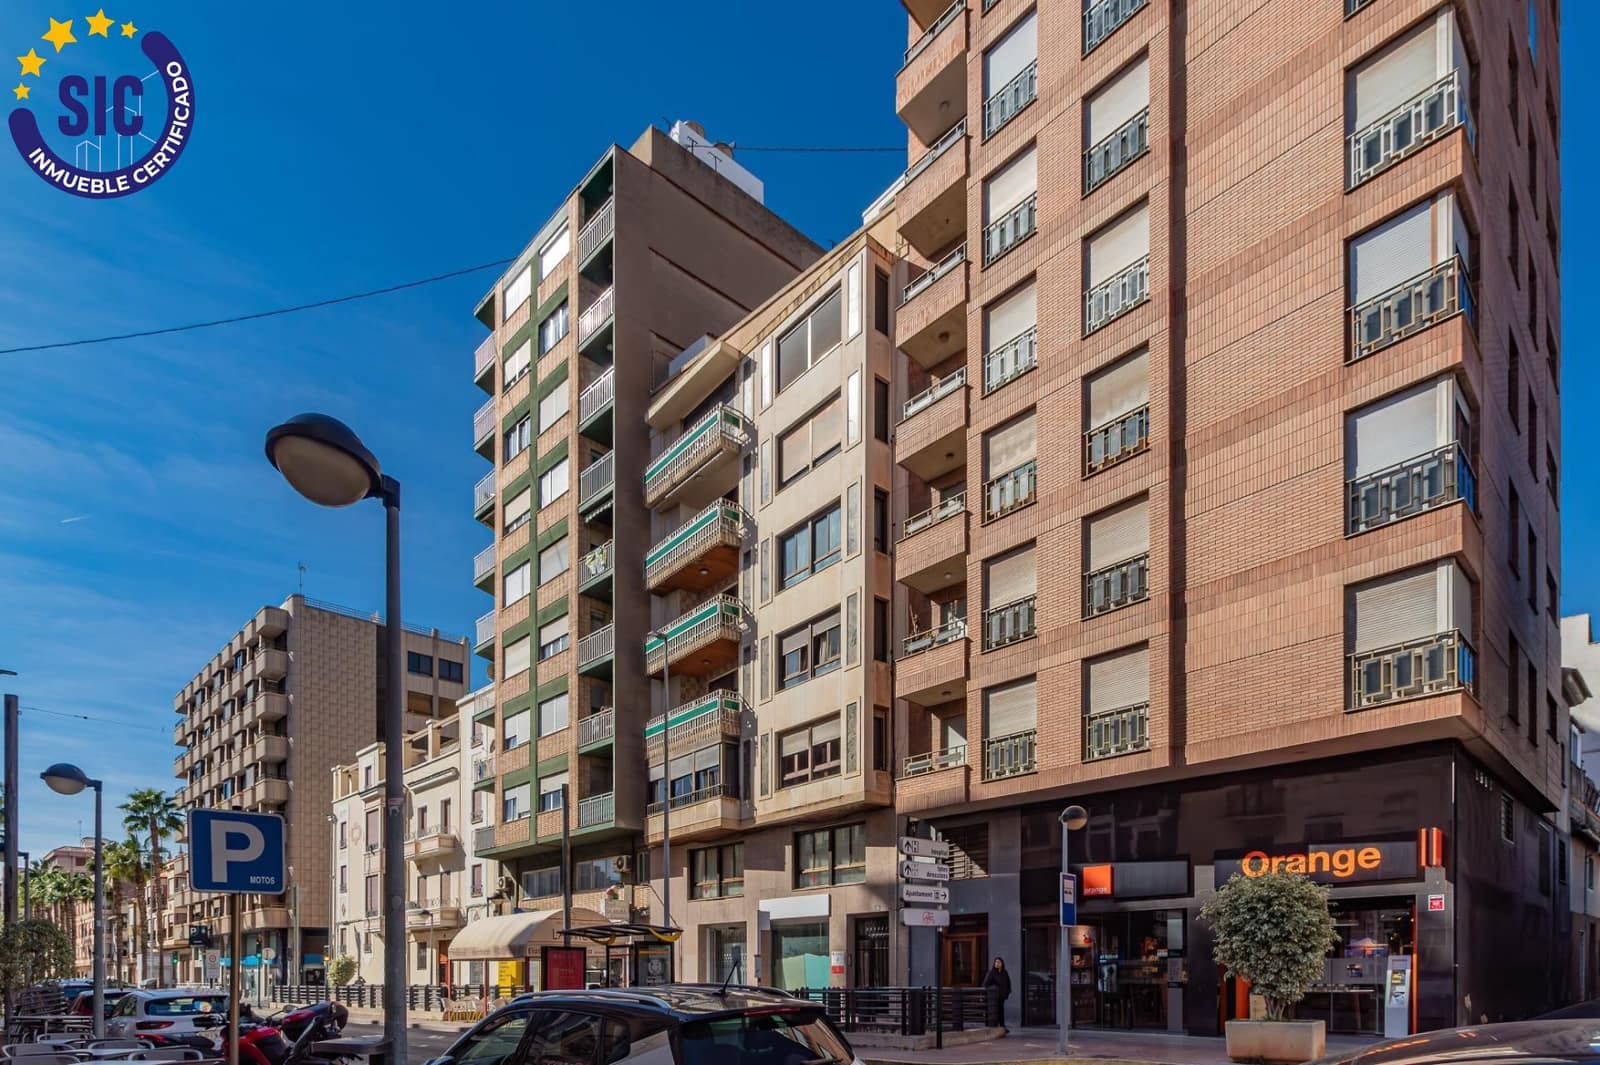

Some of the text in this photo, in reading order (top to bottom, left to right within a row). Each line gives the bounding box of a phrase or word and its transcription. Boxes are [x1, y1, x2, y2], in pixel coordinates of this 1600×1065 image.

[210, 819, 265, 883] P
[1241, 847, 1381, 878] Orange
[250, 876, 275, 884] MOTOS
